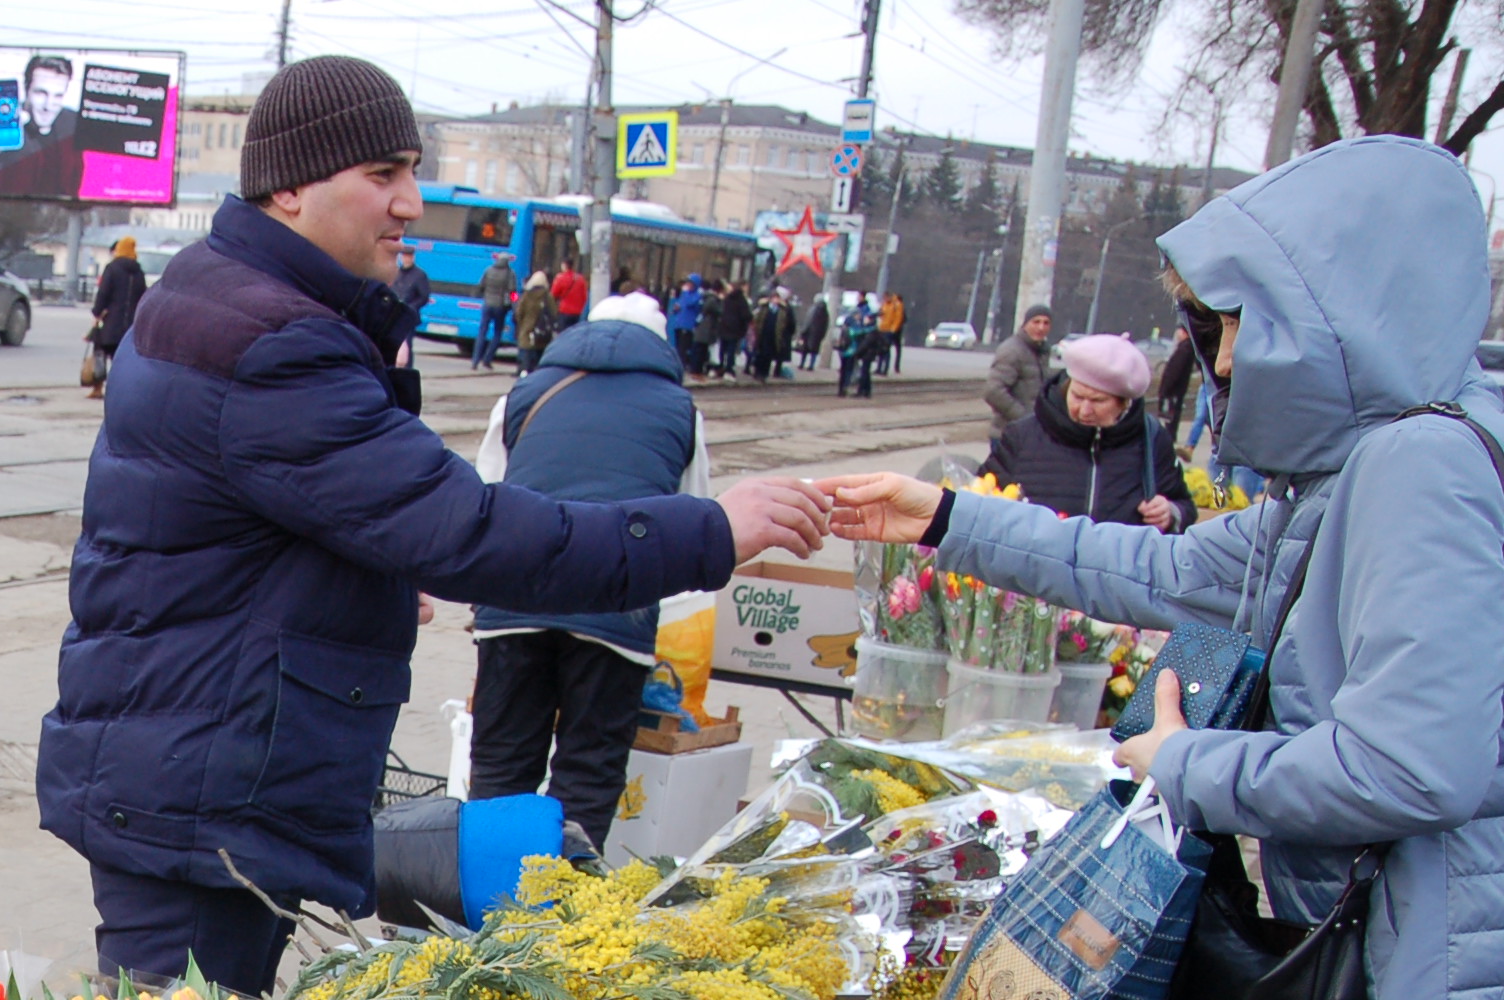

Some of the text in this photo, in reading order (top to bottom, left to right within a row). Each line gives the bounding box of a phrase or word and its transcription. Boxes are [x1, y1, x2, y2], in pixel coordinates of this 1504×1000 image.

[732, 584, 793, 607] Global
[730, 647, 776, 660] Premium
[747, 659, 791, 671] bananas
